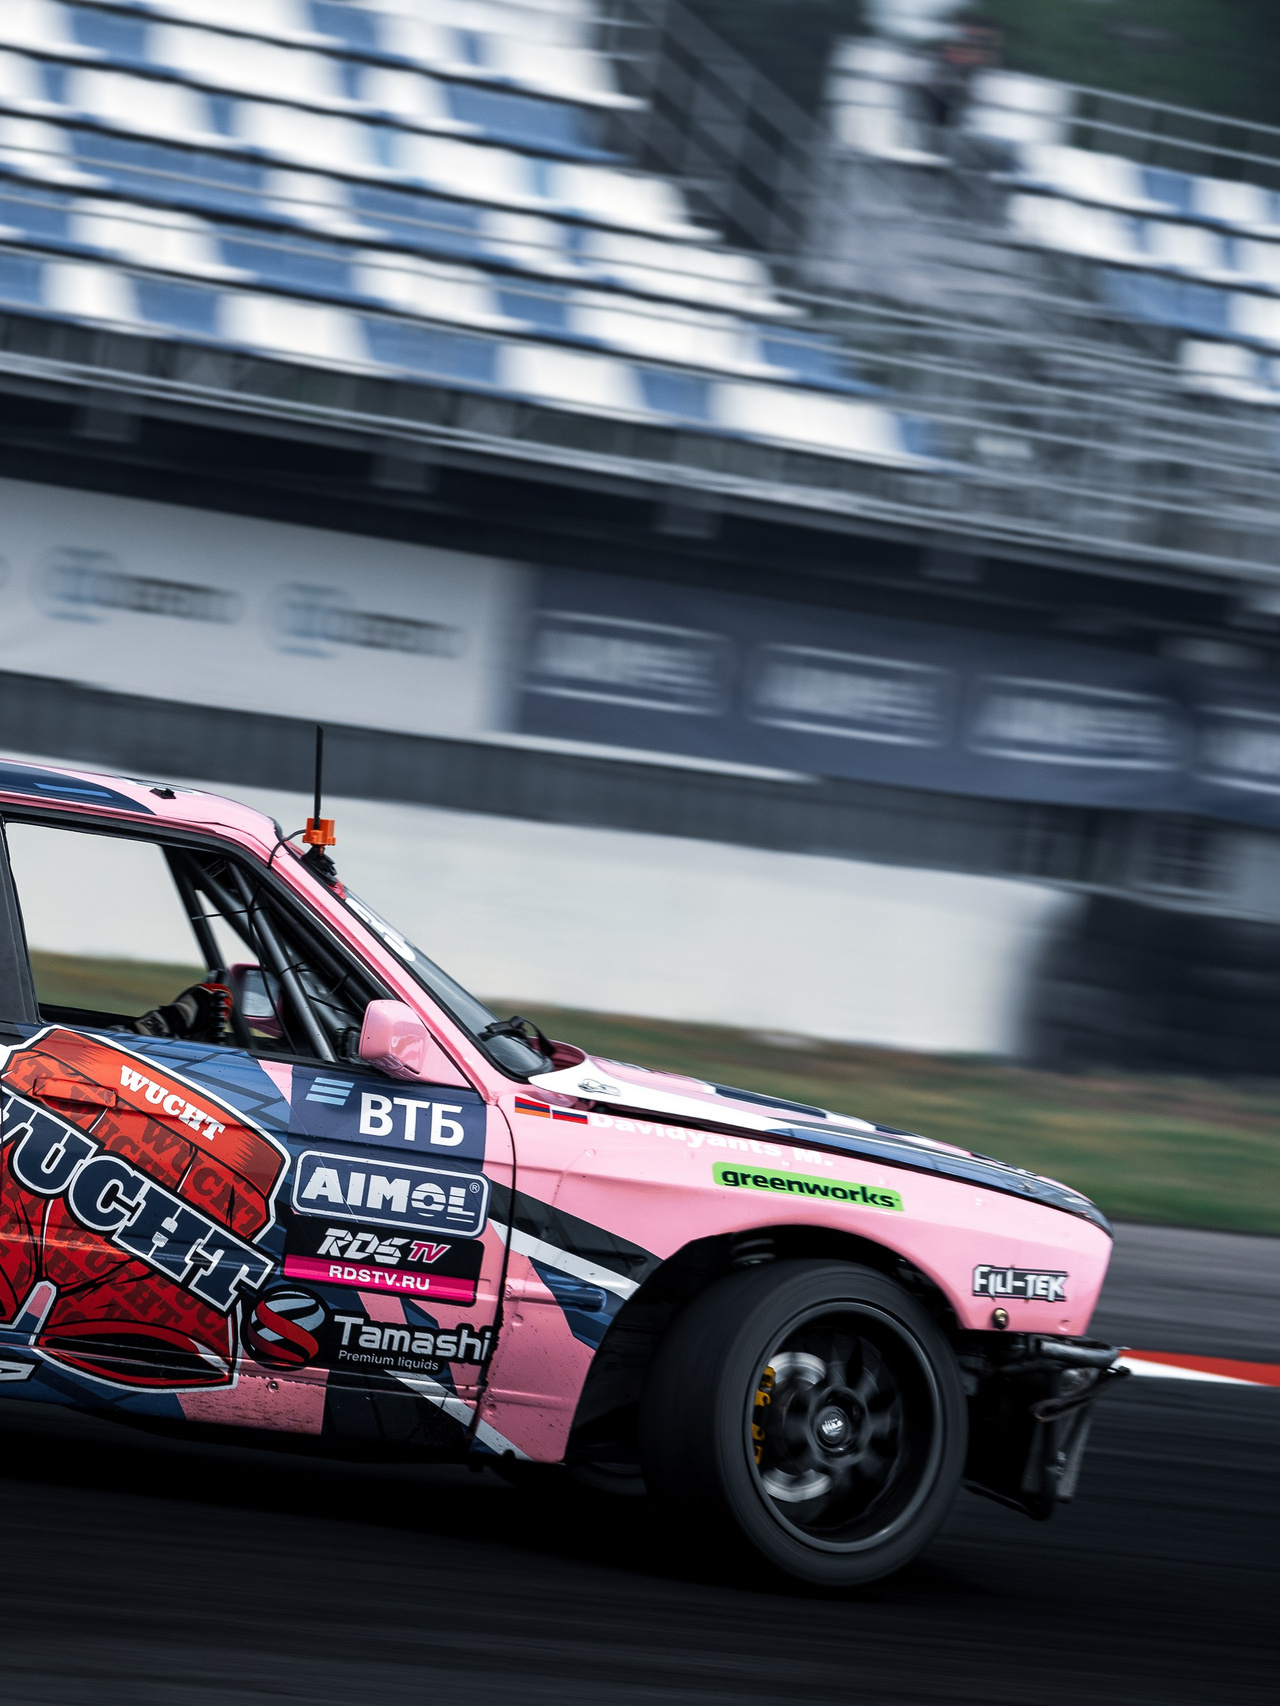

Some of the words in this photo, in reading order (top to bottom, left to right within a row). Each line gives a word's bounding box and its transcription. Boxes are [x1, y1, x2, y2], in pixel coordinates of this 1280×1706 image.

[119, 1064, 227, 1142] WUCHT
[358, 1092, 465, 1147] ВТБ
[588, 1112, 783, 1157] Davidyants
[720, 1168, 896, 1209] greenworks
[328, 1265, 431, 1291] RDSTV.RU
[333, 1314, 493, 1361] Tamashi
[338, 1349, 395, 1366] Premium
[397, 1355, 439, 1372] liquids
